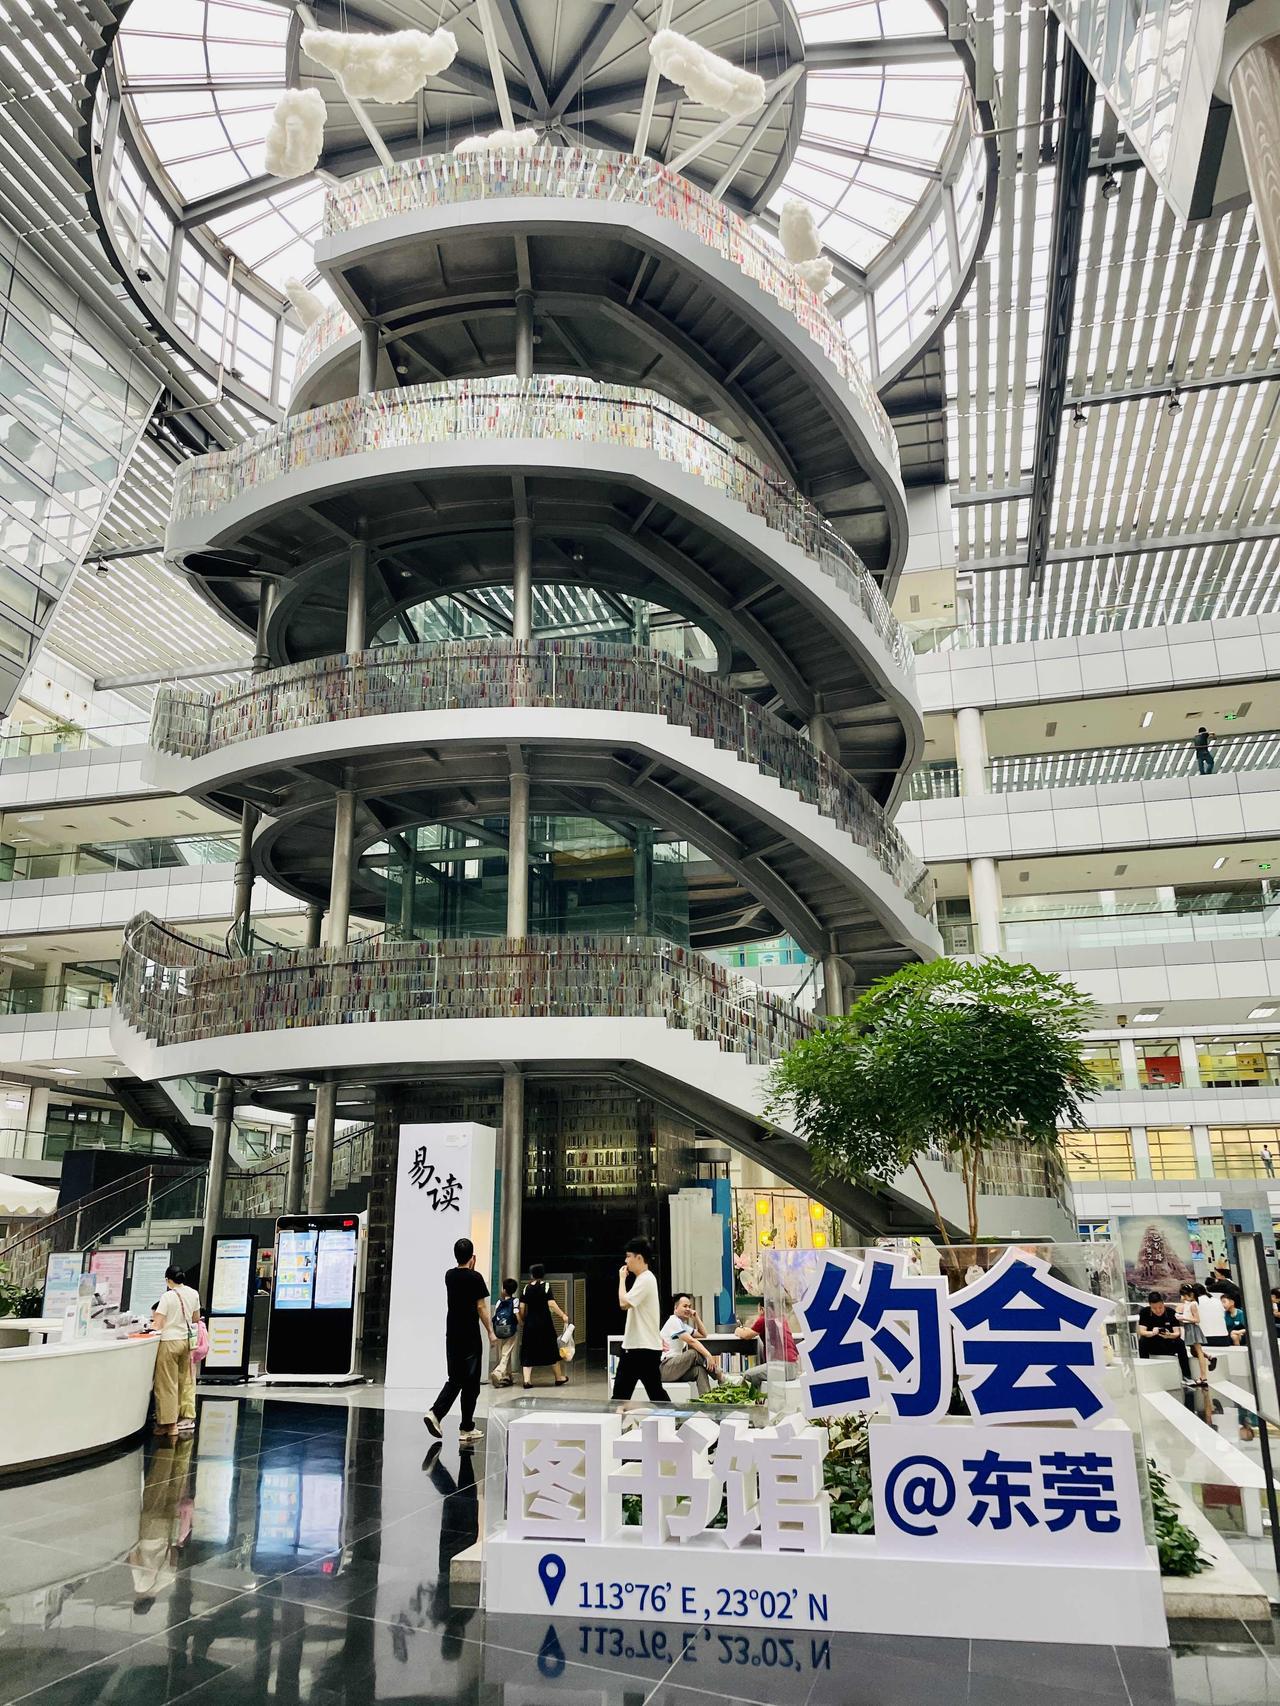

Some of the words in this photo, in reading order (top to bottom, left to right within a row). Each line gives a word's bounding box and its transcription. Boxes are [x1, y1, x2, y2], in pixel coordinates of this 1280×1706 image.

[408, 1145, 463, 1212] 易读
[804, 1261, 1104, 1420] 约会
[507, 1414, 822, 1552] 图书馆
[885, 1449, 1121, 1536] @东莞
[808, 1594, 828, 1621] N
